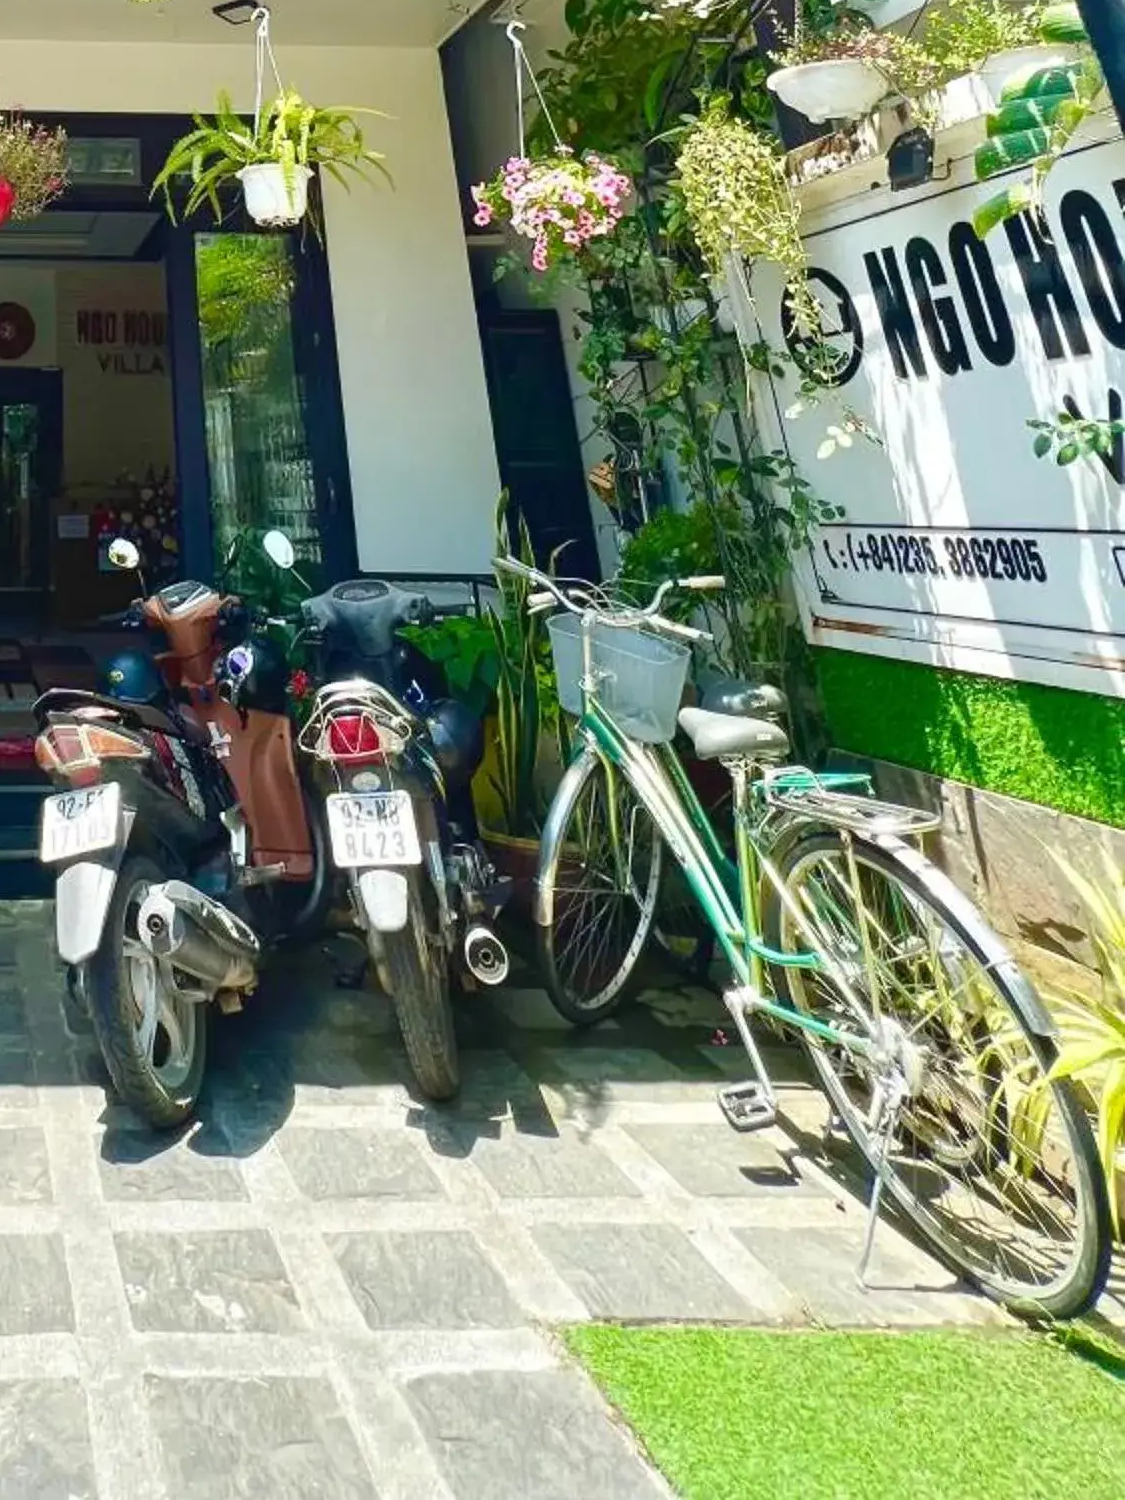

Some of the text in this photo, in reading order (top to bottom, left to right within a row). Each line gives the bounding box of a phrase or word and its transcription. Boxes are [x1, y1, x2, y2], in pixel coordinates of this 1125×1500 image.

[864, 178, 1125, 379] NGO HO
[97, 352, 165, 375] VILLA
